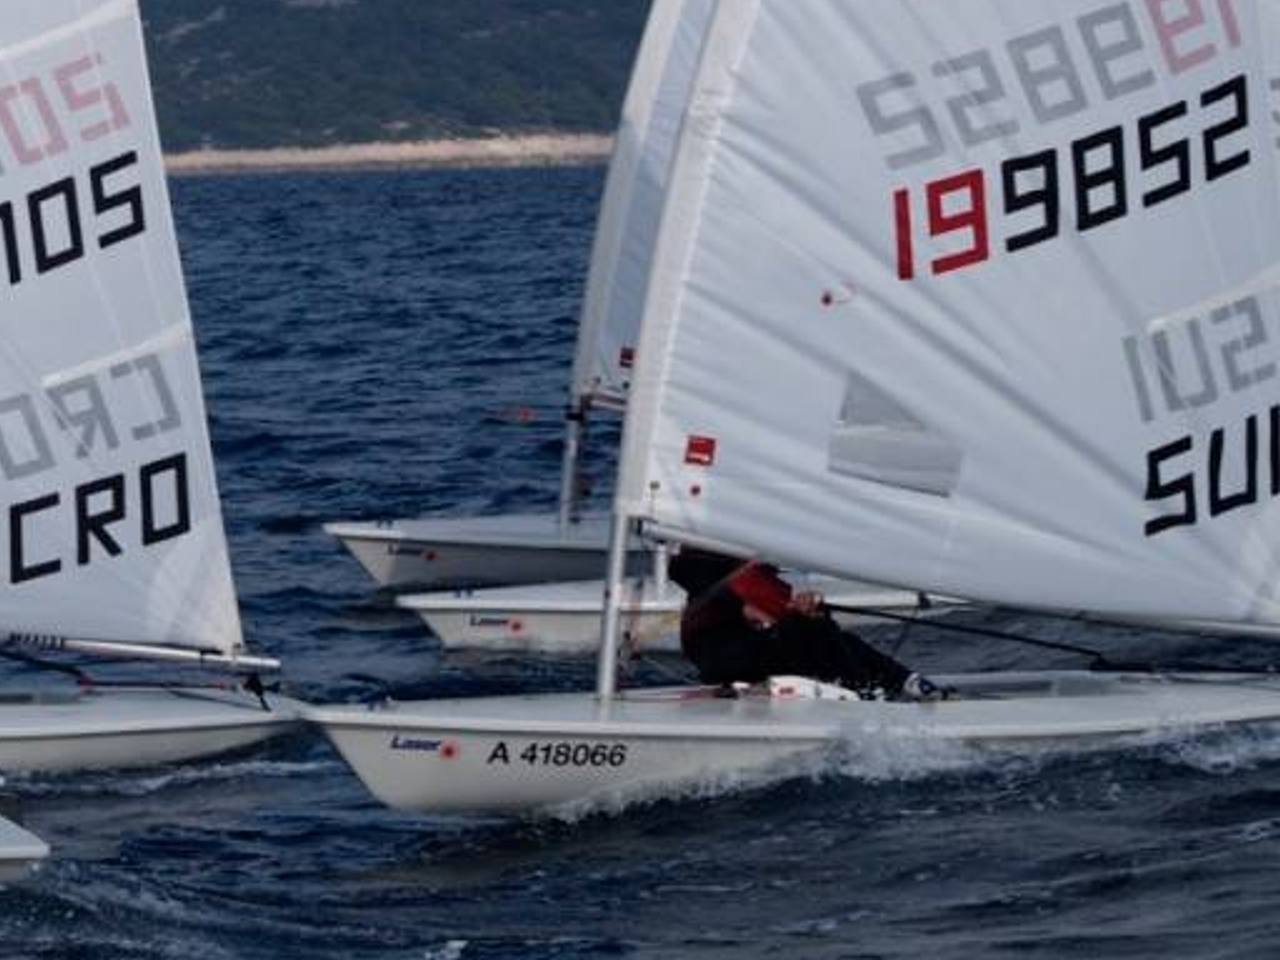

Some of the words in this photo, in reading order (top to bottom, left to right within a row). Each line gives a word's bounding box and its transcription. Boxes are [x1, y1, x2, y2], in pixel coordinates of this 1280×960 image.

[892, 74, 1251, 280] 199852
[8, 451, 191, 585] CRO
[486, 741, 511, 766] A
[520, 742, 628, 768] 418066
